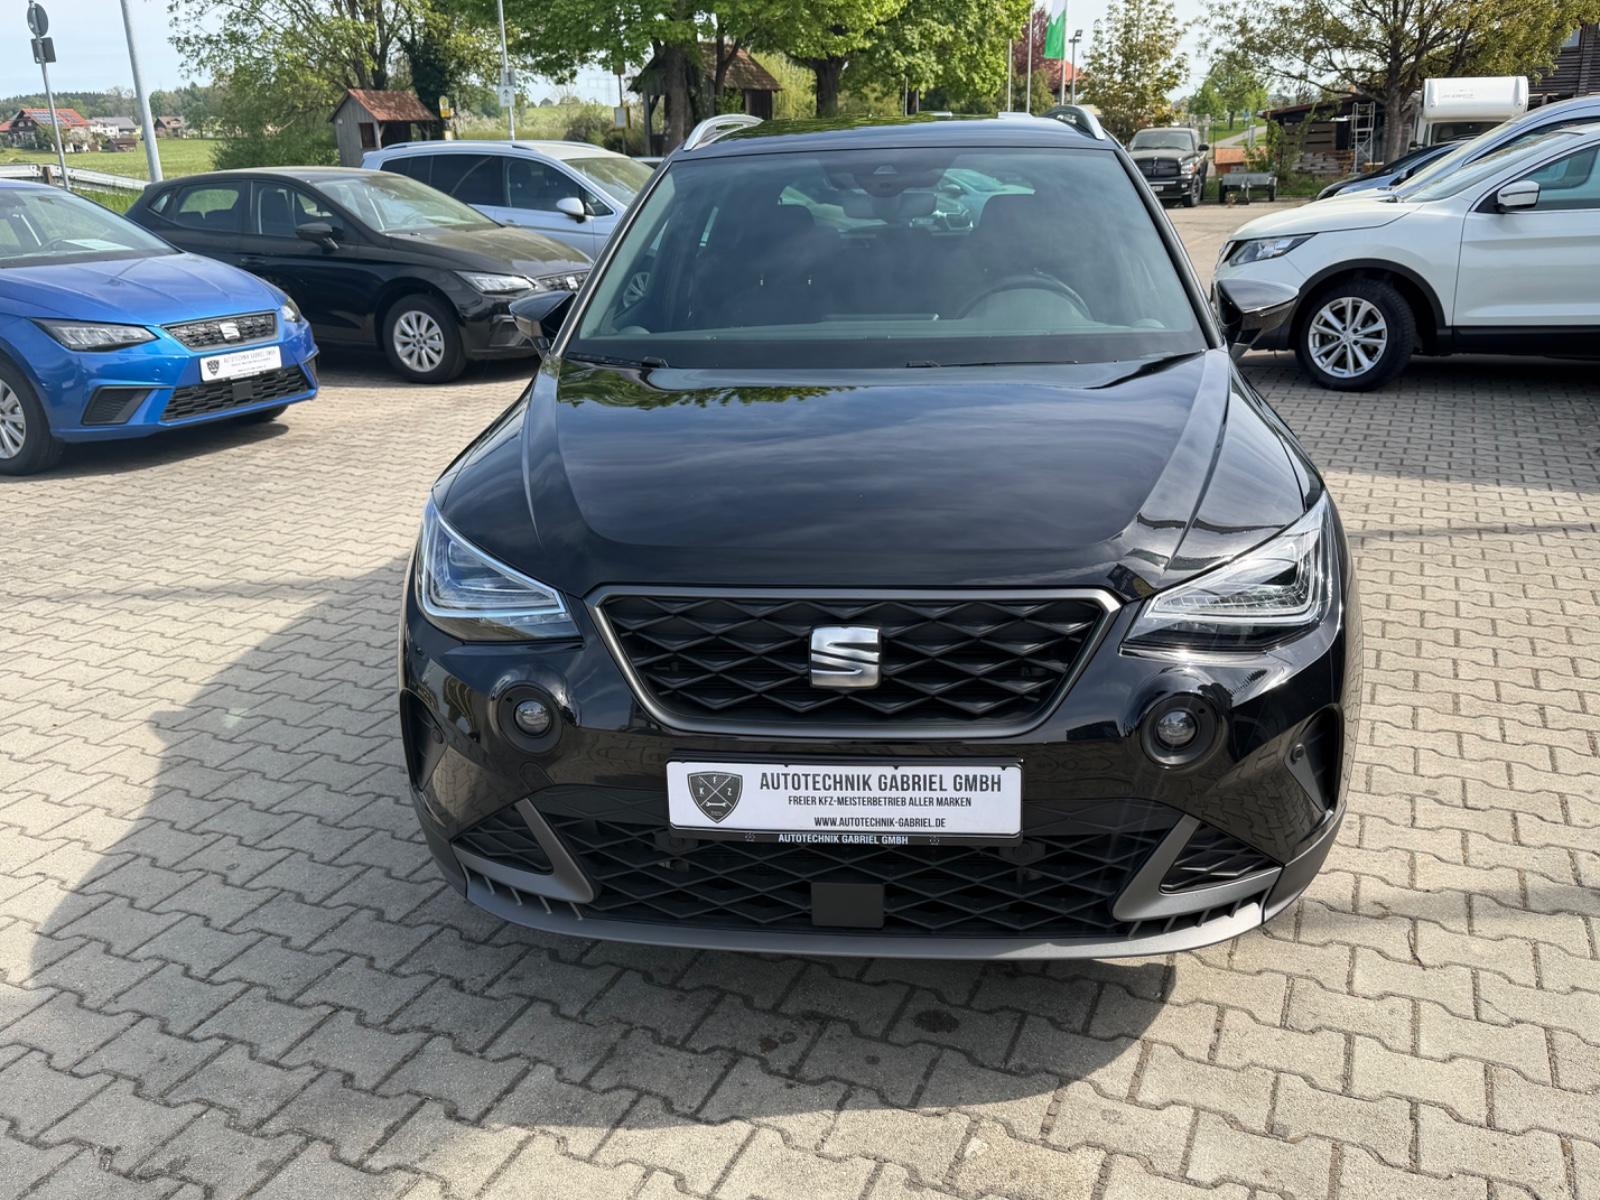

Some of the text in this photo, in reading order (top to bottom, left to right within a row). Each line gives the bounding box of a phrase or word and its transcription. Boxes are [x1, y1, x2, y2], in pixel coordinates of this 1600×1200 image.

[760, 772, 1002, 792] AUTOTECHNIK GABRIEL GMBH
[788, 796, 972, 807] FREIER KFZ-MEISTERBETRIEB ALLER MARKEN
[814, 816, 946, 828] WWW.AUTOTECHNIK-GABRIEL.DE
[778, 834, 909, 845] AUTOTECHNIK GABRIEL GMBH
